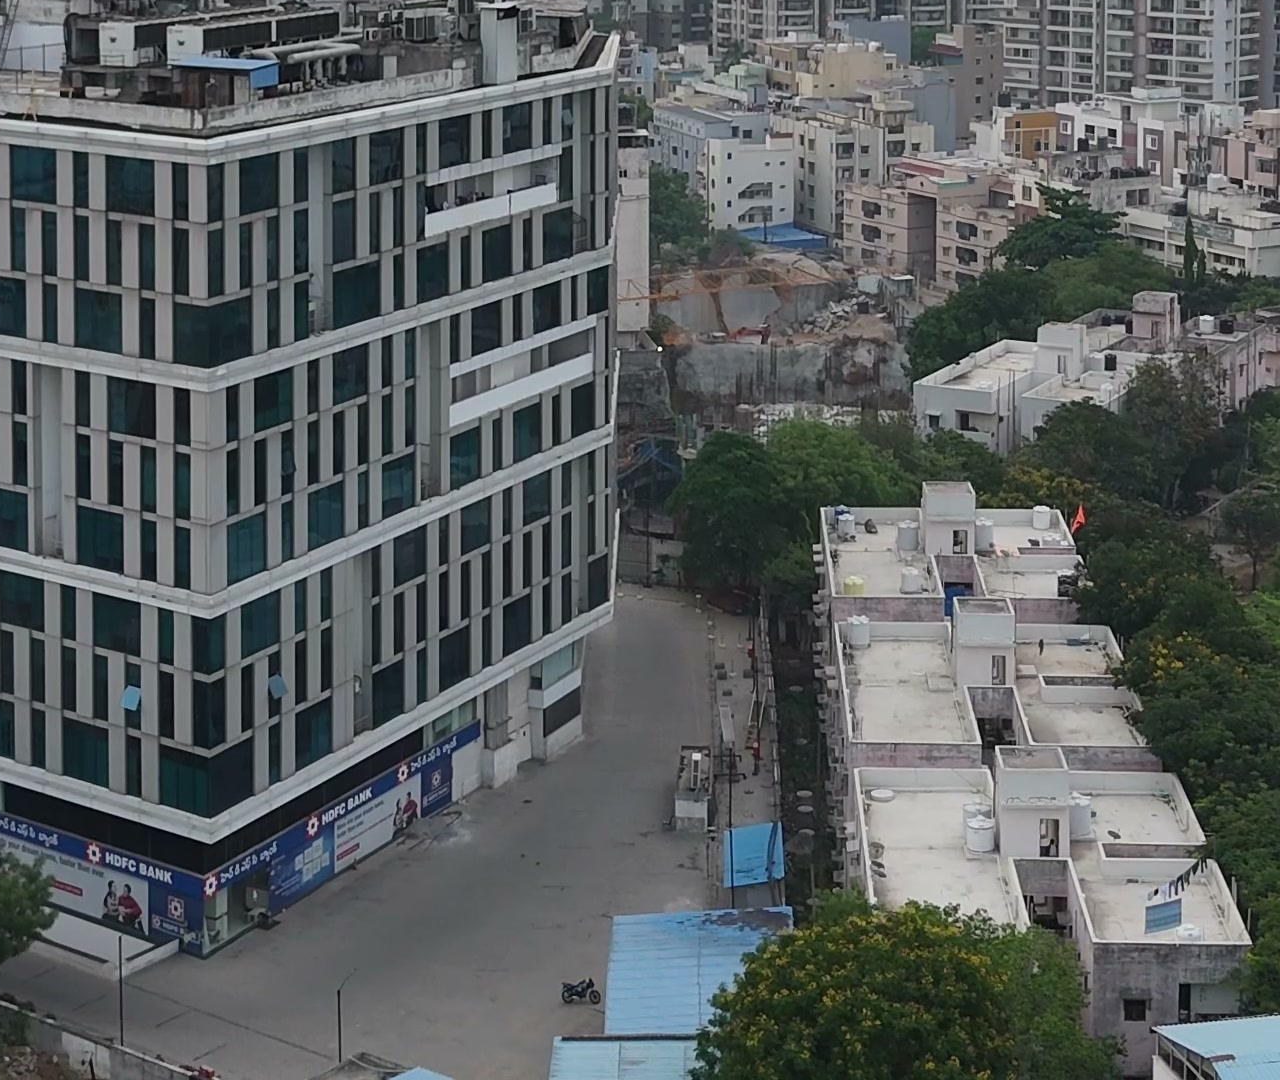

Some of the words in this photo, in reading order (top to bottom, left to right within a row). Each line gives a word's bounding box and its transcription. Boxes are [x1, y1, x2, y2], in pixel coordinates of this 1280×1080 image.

[322, 804, 346, 826] HDFC
[347, 787, 373, 810] BANK
[105, 852, 137, 872] HDFC
[138, 862, 173, 885] BANK
